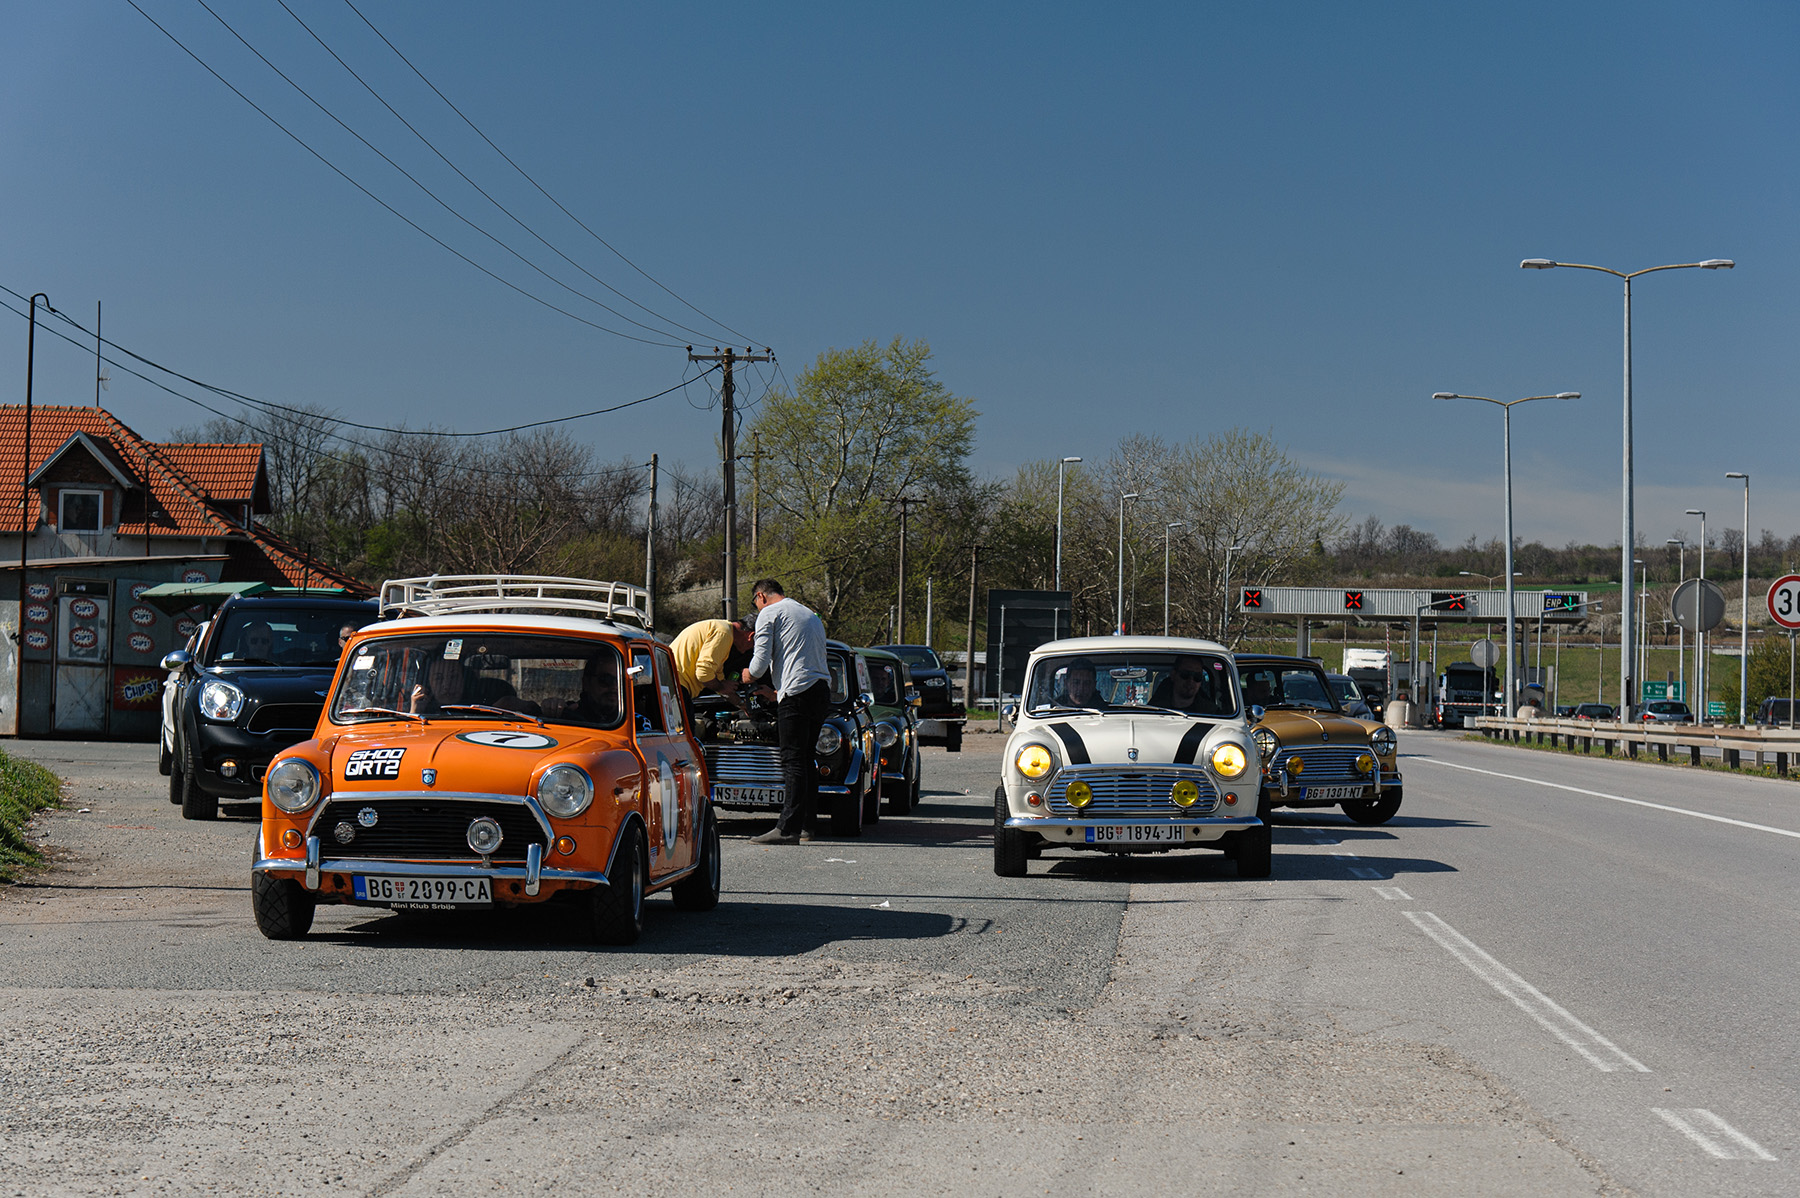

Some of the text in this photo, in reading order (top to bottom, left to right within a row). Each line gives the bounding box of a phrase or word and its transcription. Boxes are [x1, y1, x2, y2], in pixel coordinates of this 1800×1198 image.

[1545, 598, 1562, 608] ENP
[1778, 588, 1800, 616] 3
[124, 679, 158, 700] CHIPSY
[490, 733, 530, 744] 7
[350, 749, 405, 761] SHOO
[716, 787, 732, 800] NS
[1306, 788, 1319, 799] BG
[1096, 825, 1114, 840] BG
[368, 878, 393, 899] BG
[410, 902, 430, 910] Klub
[431, 903, 456, 911] Srbije
